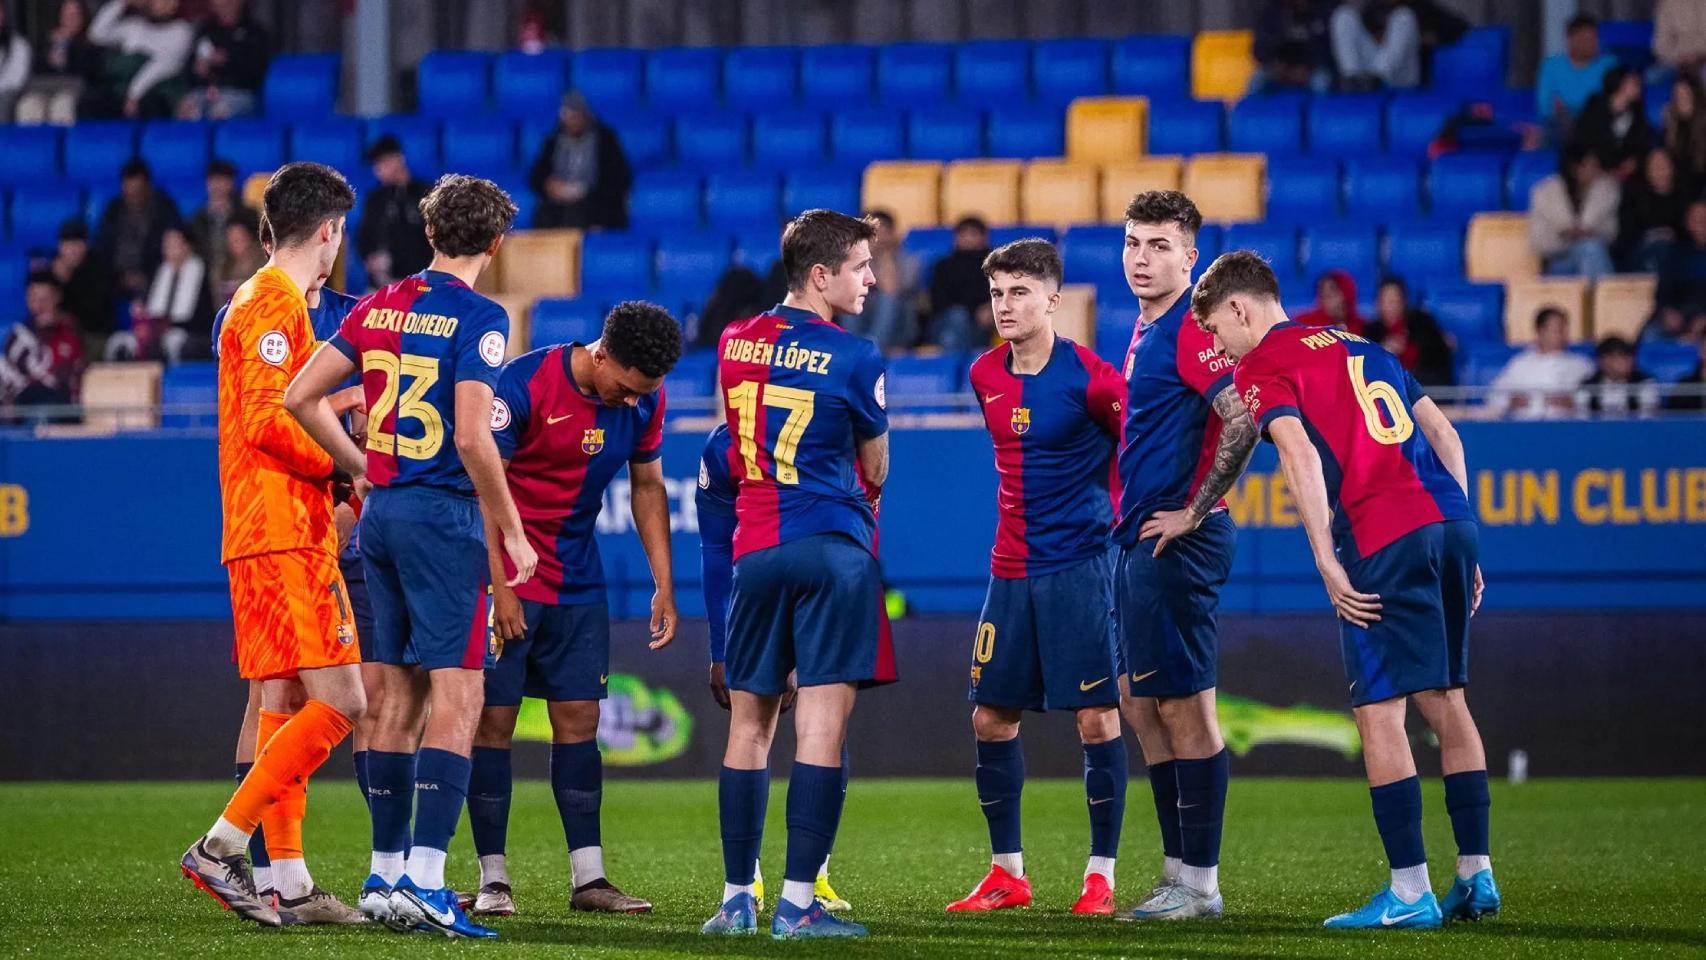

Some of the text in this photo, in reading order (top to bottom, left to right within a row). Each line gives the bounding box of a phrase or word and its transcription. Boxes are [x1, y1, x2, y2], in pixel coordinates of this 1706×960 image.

[724, 338, 832, 375] RUBÉN LÓPEZ
[1198, 348, 1218, 363] BA
[1300, 330, 1338, 350] PAU
[362, 349, 444, 460] 23
[1347, 355, 1414, 445] 6
[727, 380, 815, 484] 17
[1224, 466, 1706, 527] MÉ UN CLUB
[328, 581, 347, 620] 1
[976, 622, 996, 663] 0
